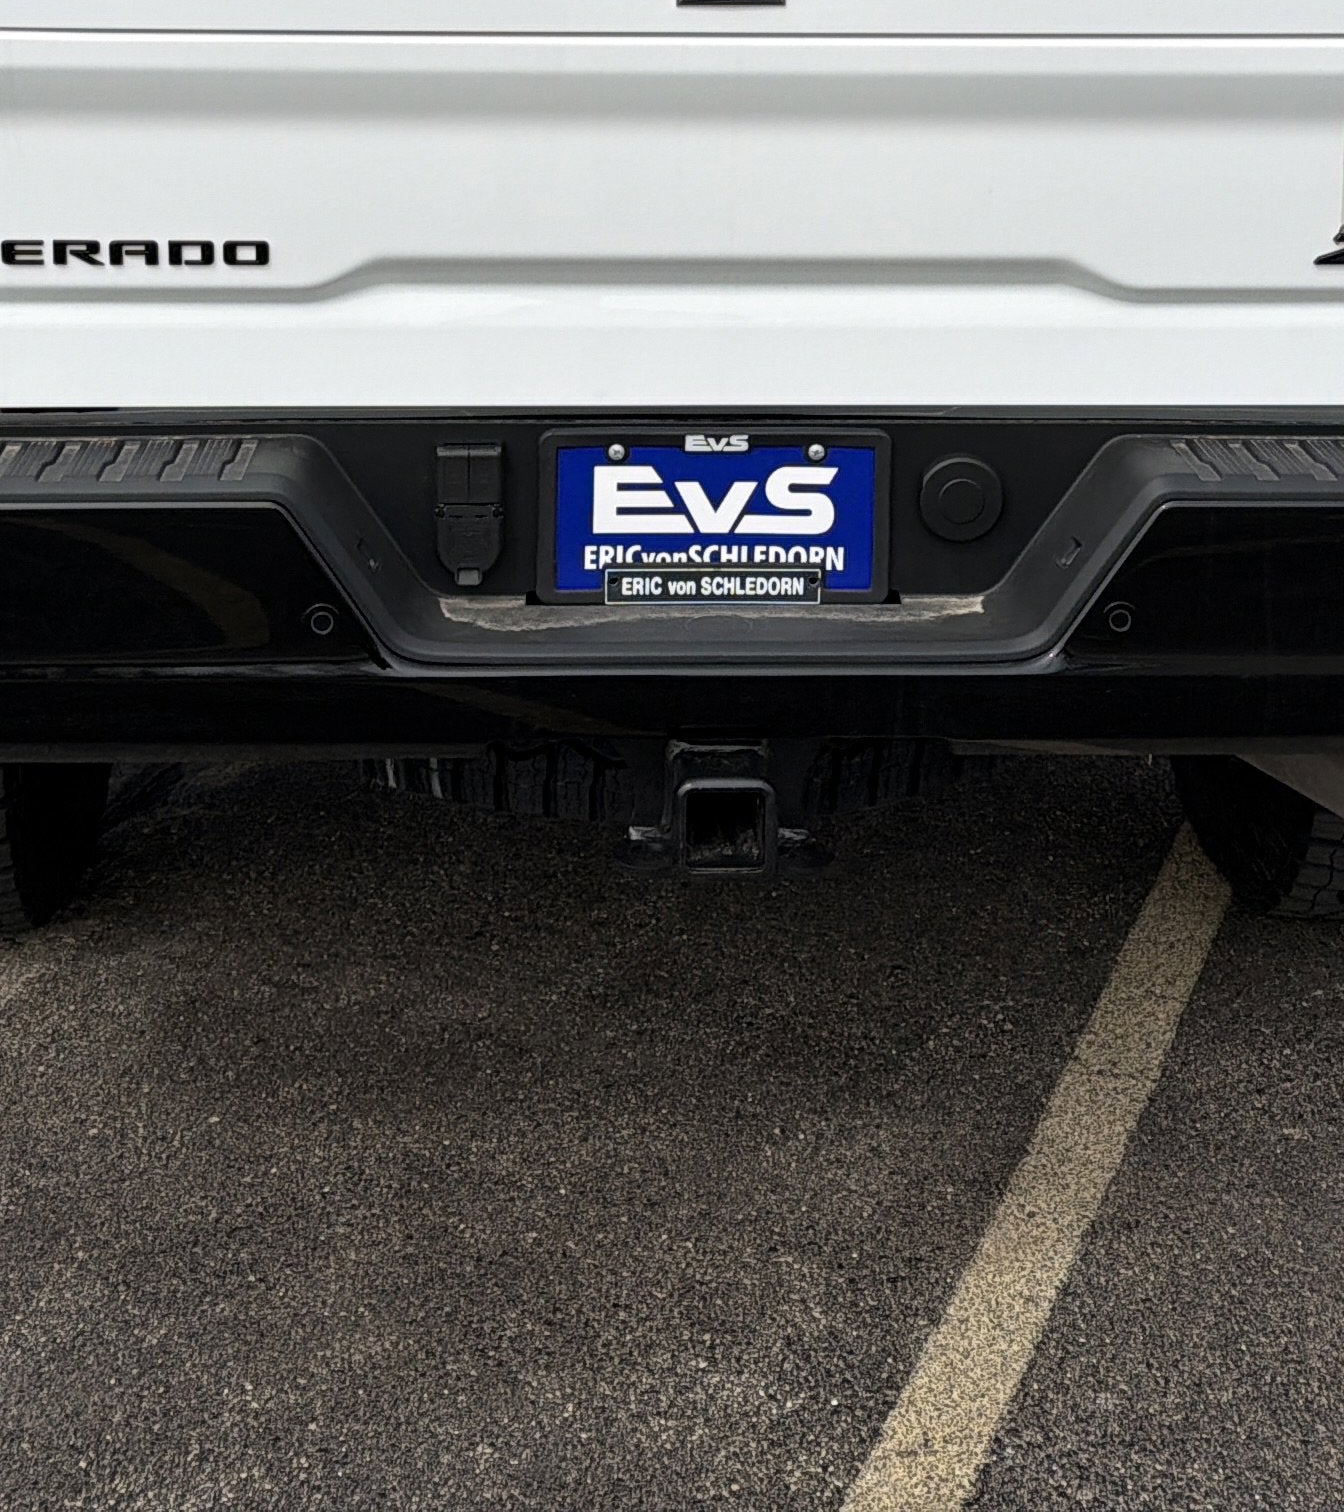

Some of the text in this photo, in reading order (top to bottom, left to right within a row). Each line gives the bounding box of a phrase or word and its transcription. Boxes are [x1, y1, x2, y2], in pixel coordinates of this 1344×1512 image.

[621, 577, 805, 596] ERIC von SCHLEDORN
